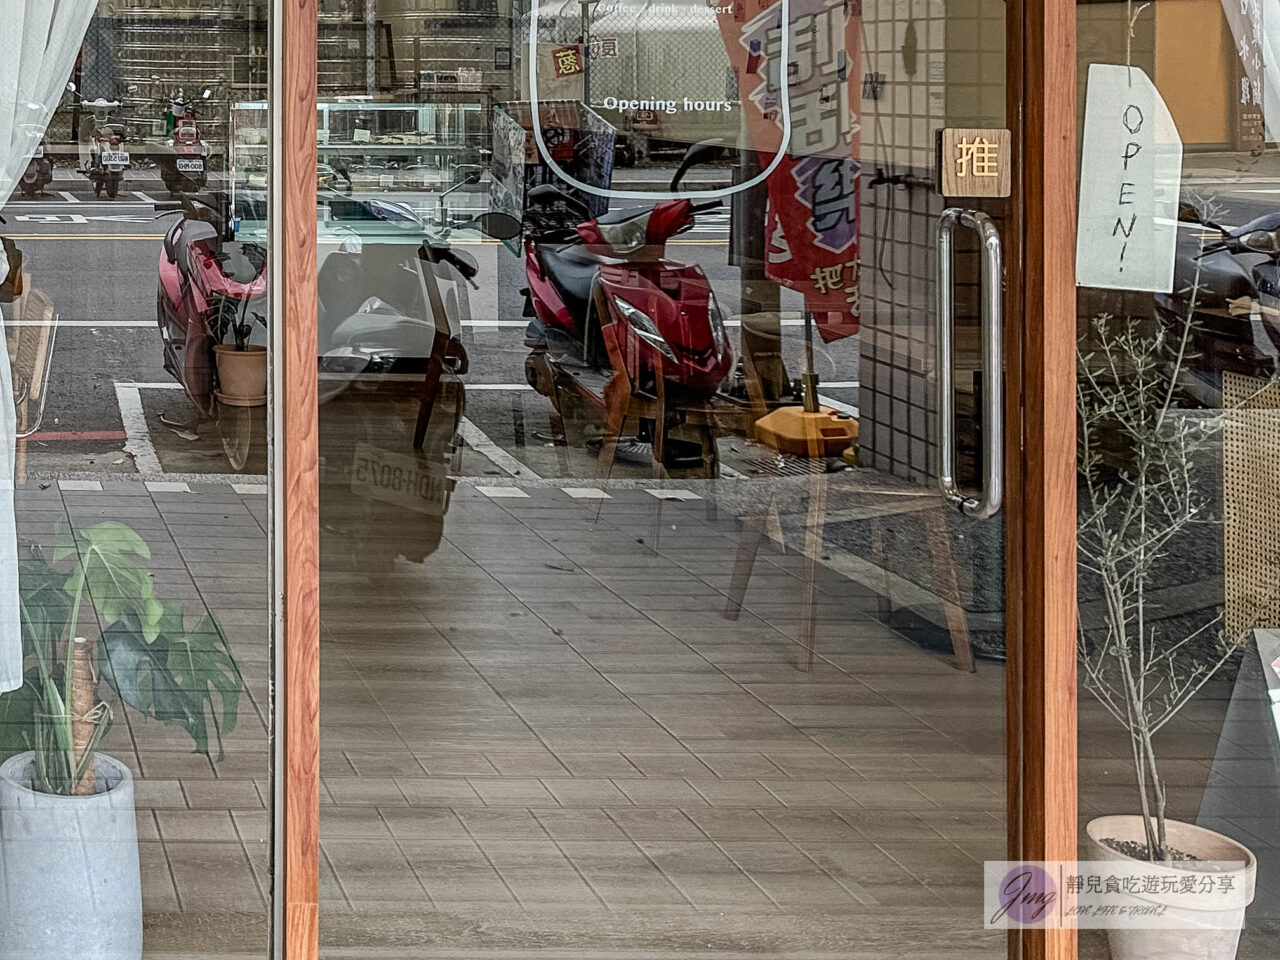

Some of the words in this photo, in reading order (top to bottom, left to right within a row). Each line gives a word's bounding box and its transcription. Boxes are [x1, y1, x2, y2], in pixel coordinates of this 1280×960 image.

[648, 3, 678, 13] drink
[690, 3, 733, 14] dessert
[603, 96, 677, 114] Opening
[683, 96, 732, 112] hours
[956, 137, 998, 177] 推
